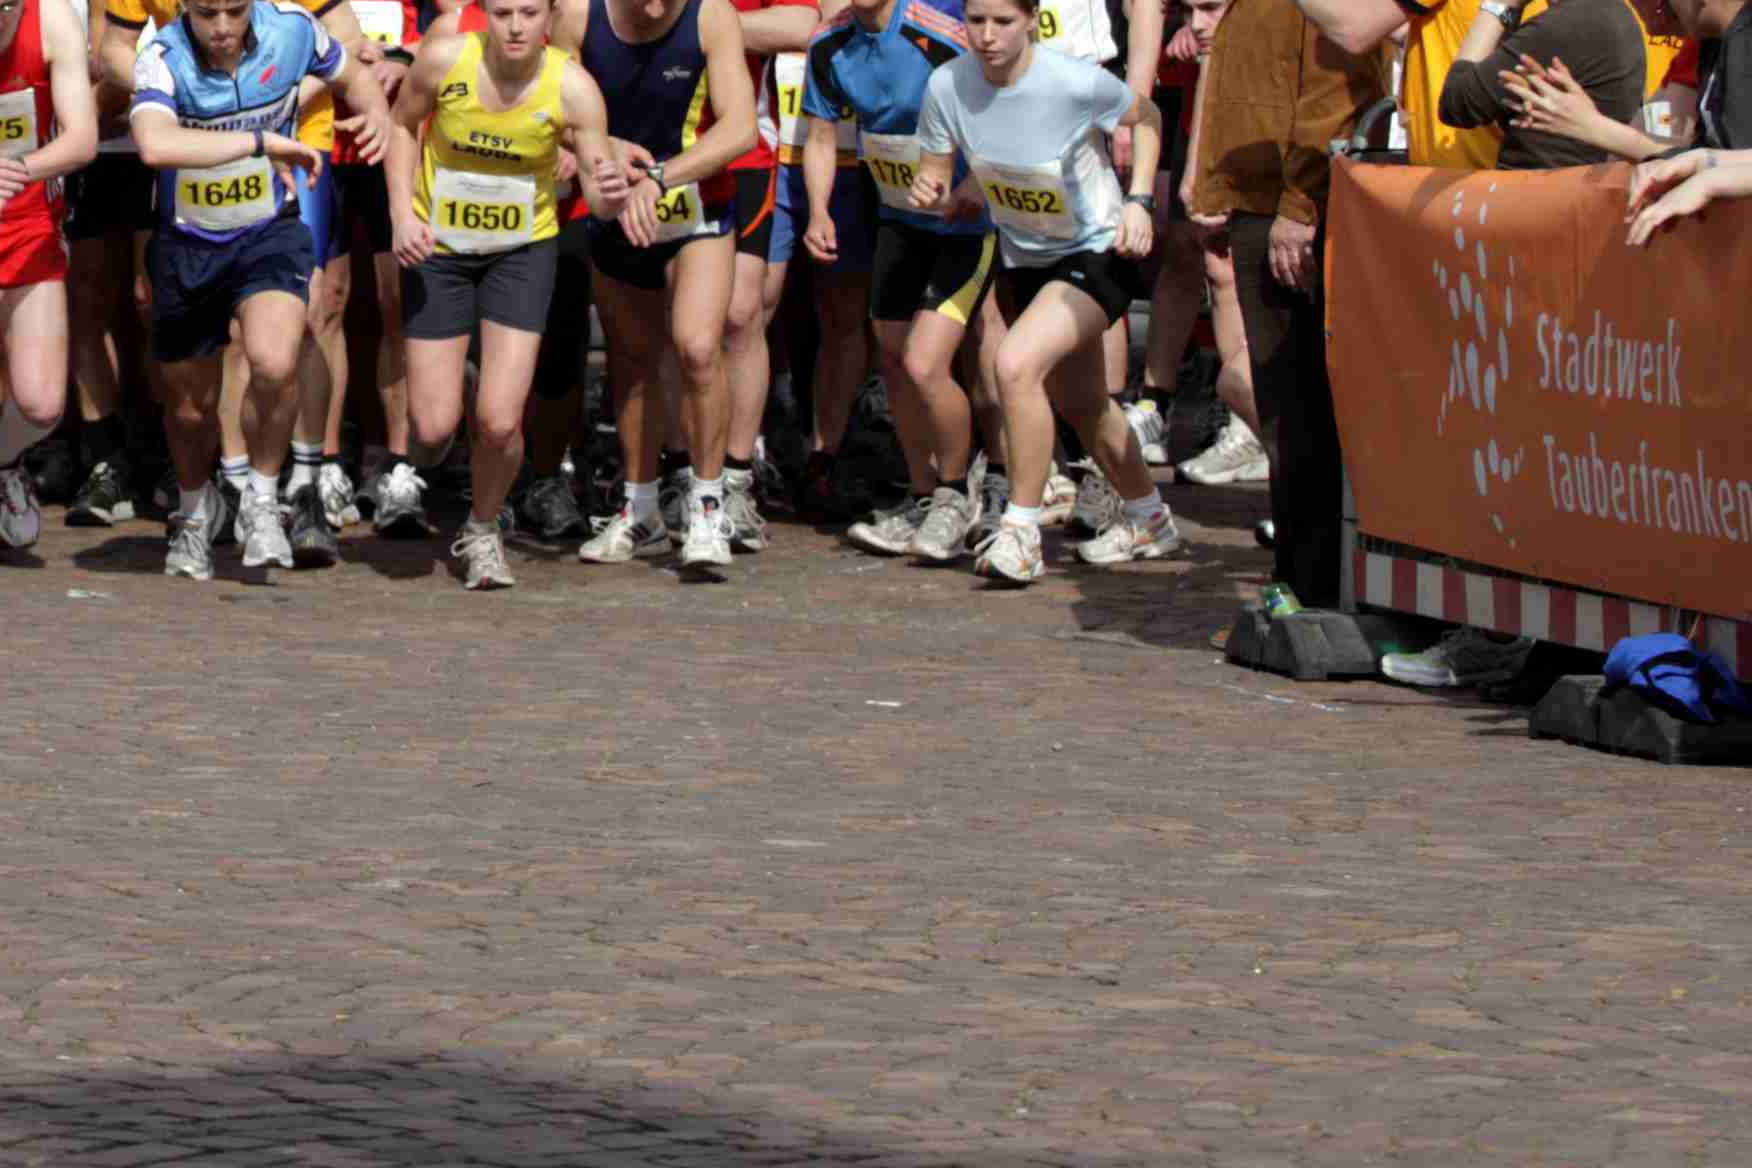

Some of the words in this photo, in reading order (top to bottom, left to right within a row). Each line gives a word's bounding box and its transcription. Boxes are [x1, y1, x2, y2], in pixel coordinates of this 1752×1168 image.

[469, 131, 513, 149] ETSV
[186, 174, 262, 206] 1648
[987, 184, 1061, 214] 1652
[445, 201, 521, 230] 1650
[655, 192, 690, 223] 54
[1535, 308, 1682, 408] Stadtwerk
[1542, 431, 1752, 544] Tauberfranken
